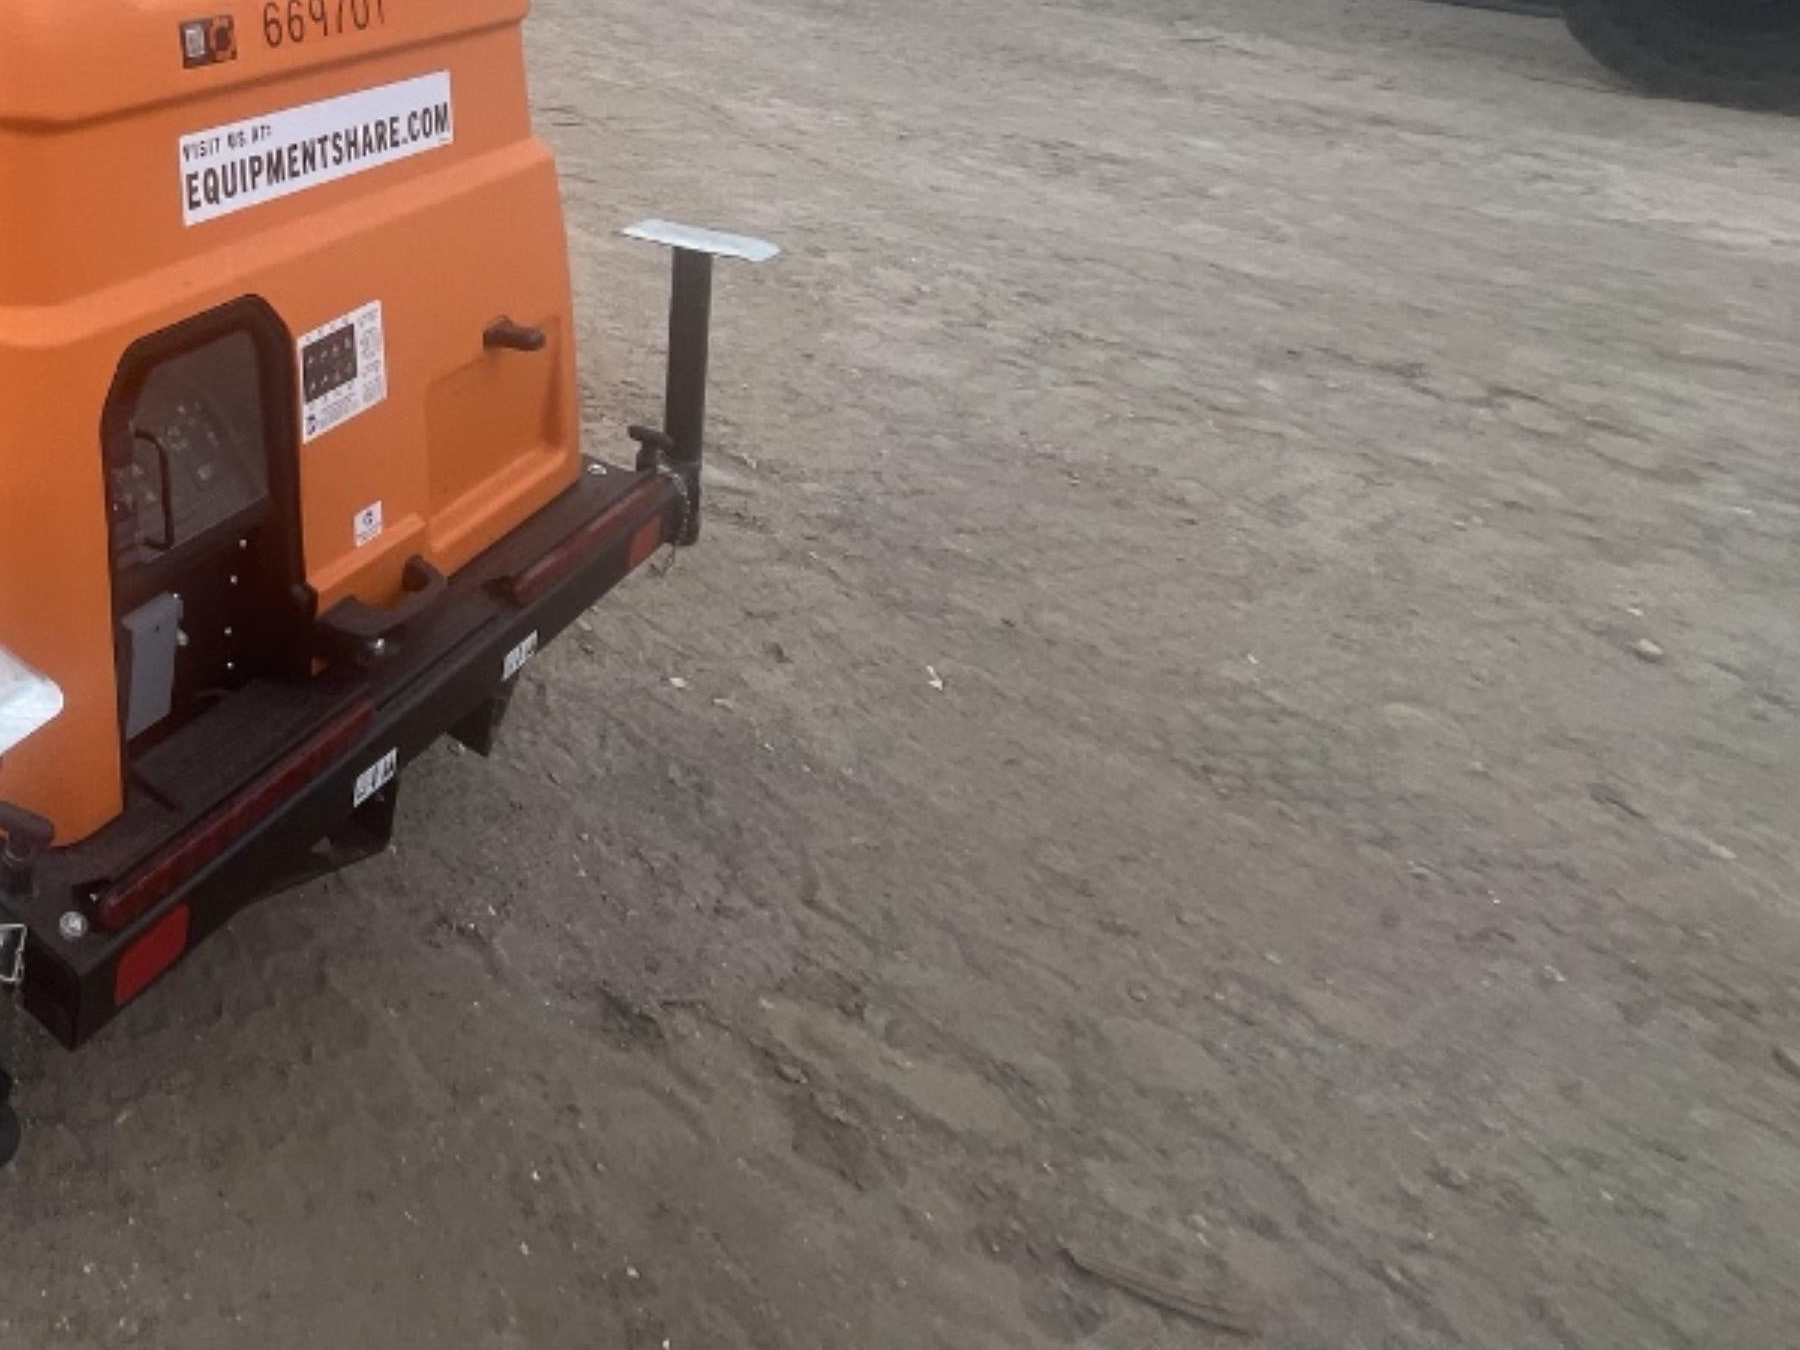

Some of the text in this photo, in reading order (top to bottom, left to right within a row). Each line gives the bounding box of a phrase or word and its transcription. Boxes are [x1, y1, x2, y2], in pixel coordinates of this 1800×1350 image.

[183, 124, 272, 162] VISIT US AT:
[185, 101, 450, 211] EQUIPMENTSHARE.COM
